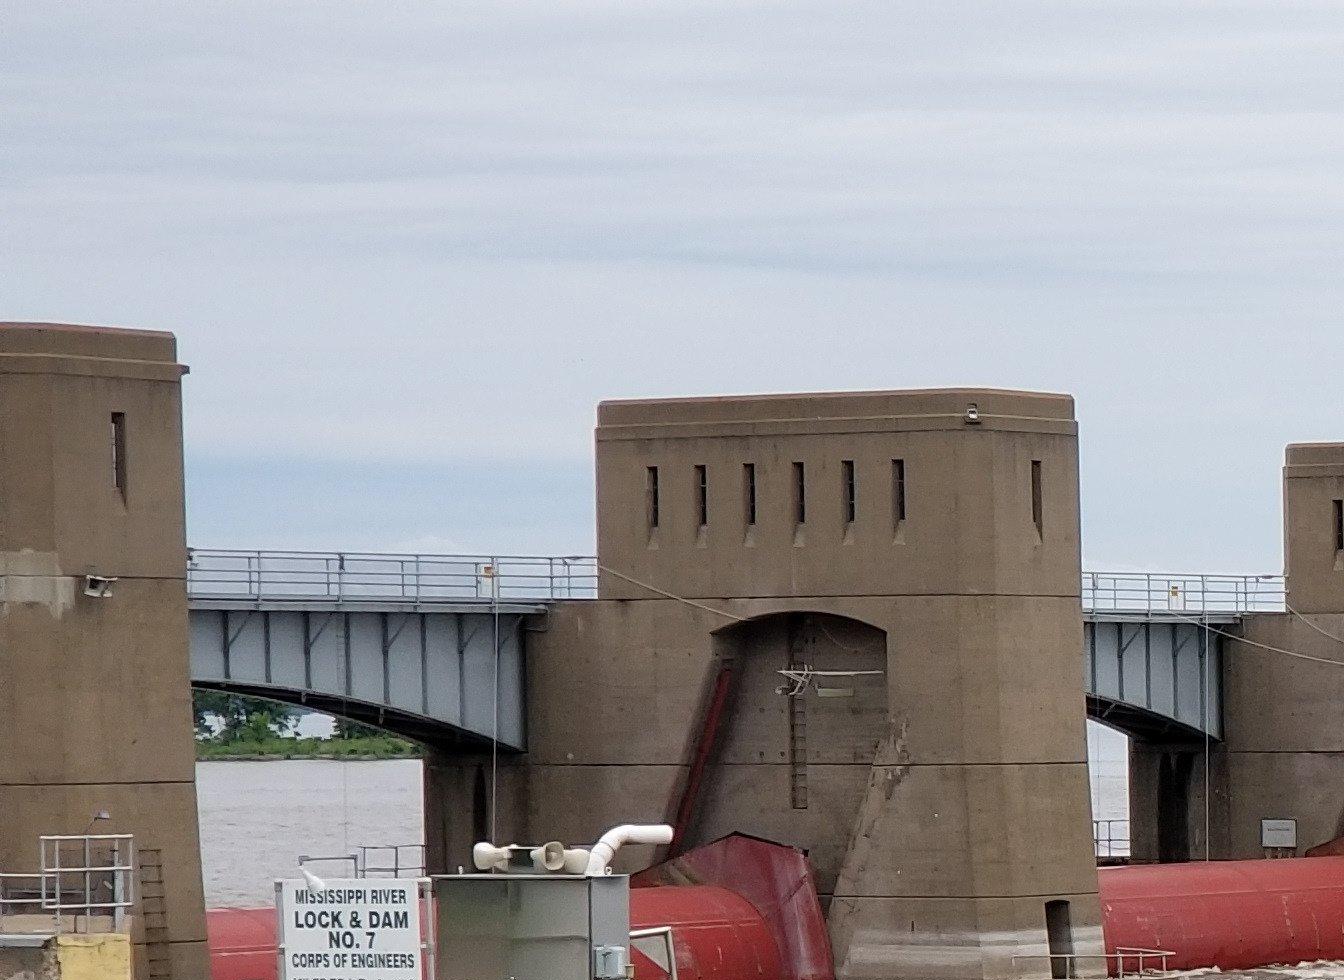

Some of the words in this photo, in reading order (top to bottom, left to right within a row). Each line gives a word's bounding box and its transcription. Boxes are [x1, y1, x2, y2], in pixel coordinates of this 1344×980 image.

[295, 889, 367, 904] MISSISSIPPI
[371, 889, 407, 904] RIVER
[294, 910, 343, 929] LOCK
[349, 910, 362, 928] &
[368, 910, 409, 928] DAM
[328, 931, 360, 949] NO.
[365, 931, 376, 949] 7
[292, 953, 330, 968] CORPS
[333, 953, 348, 968] OF
[351, 953, 415, 969] ENGINEERS
